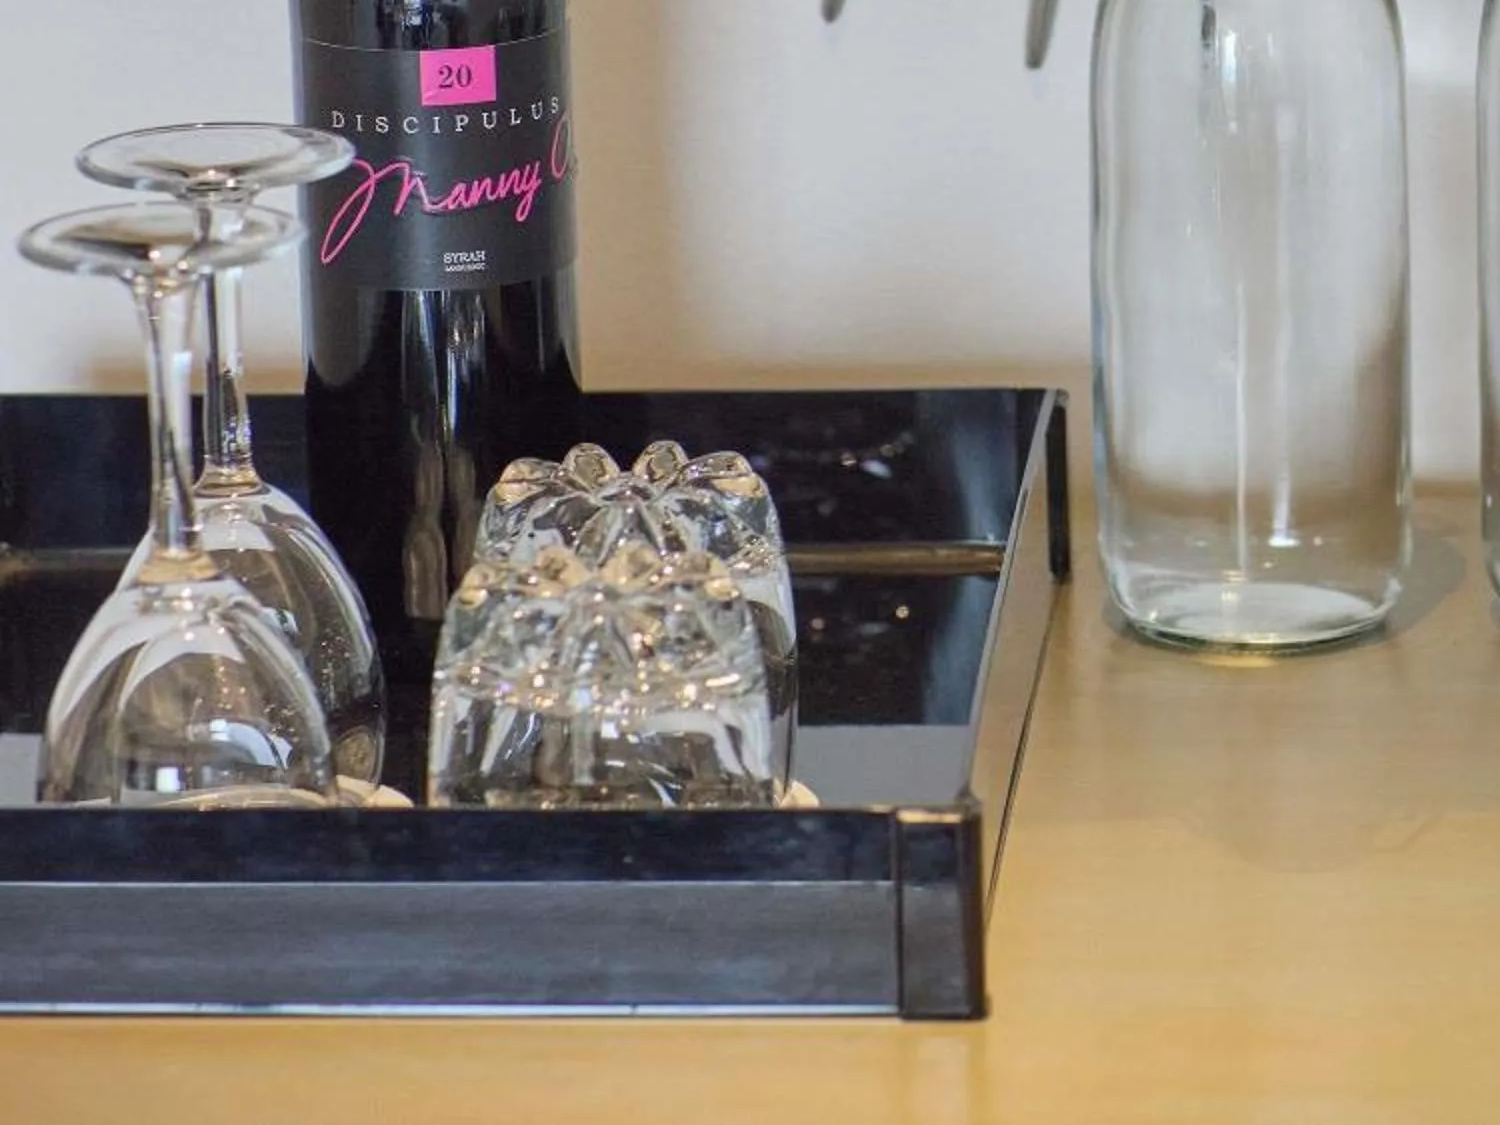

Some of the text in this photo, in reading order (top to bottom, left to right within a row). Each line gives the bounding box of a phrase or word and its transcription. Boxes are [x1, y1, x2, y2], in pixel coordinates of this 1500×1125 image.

[437, 62, 473, 89] 20
[331, 96, 560, 134] DISCIPULUS
[320, 154, 542, 265] Manny
[443, 250, 486, 264] SYRAH
